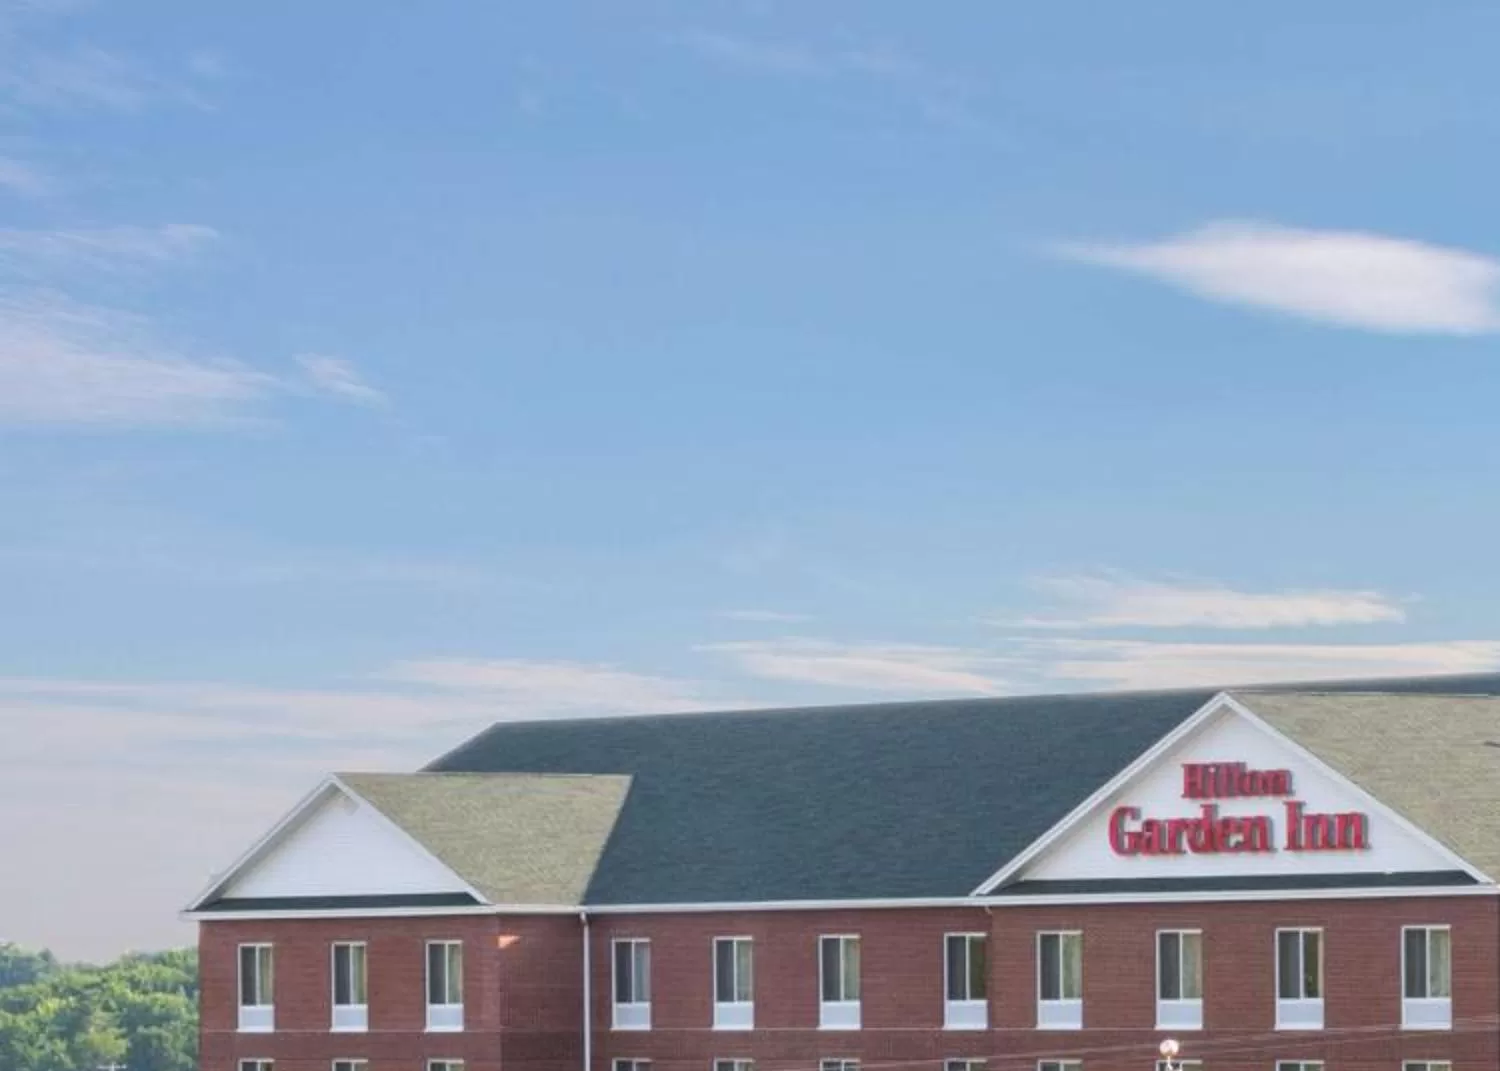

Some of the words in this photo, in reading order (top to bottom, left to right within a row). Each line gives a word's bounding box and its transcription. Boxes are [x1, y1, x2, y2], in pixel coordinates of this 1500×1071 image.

[1182, 762, 1293, 798] Hilton
[1109, 803, 1272, 856] Garden
[1284, 801, 1369, 851] Inn
